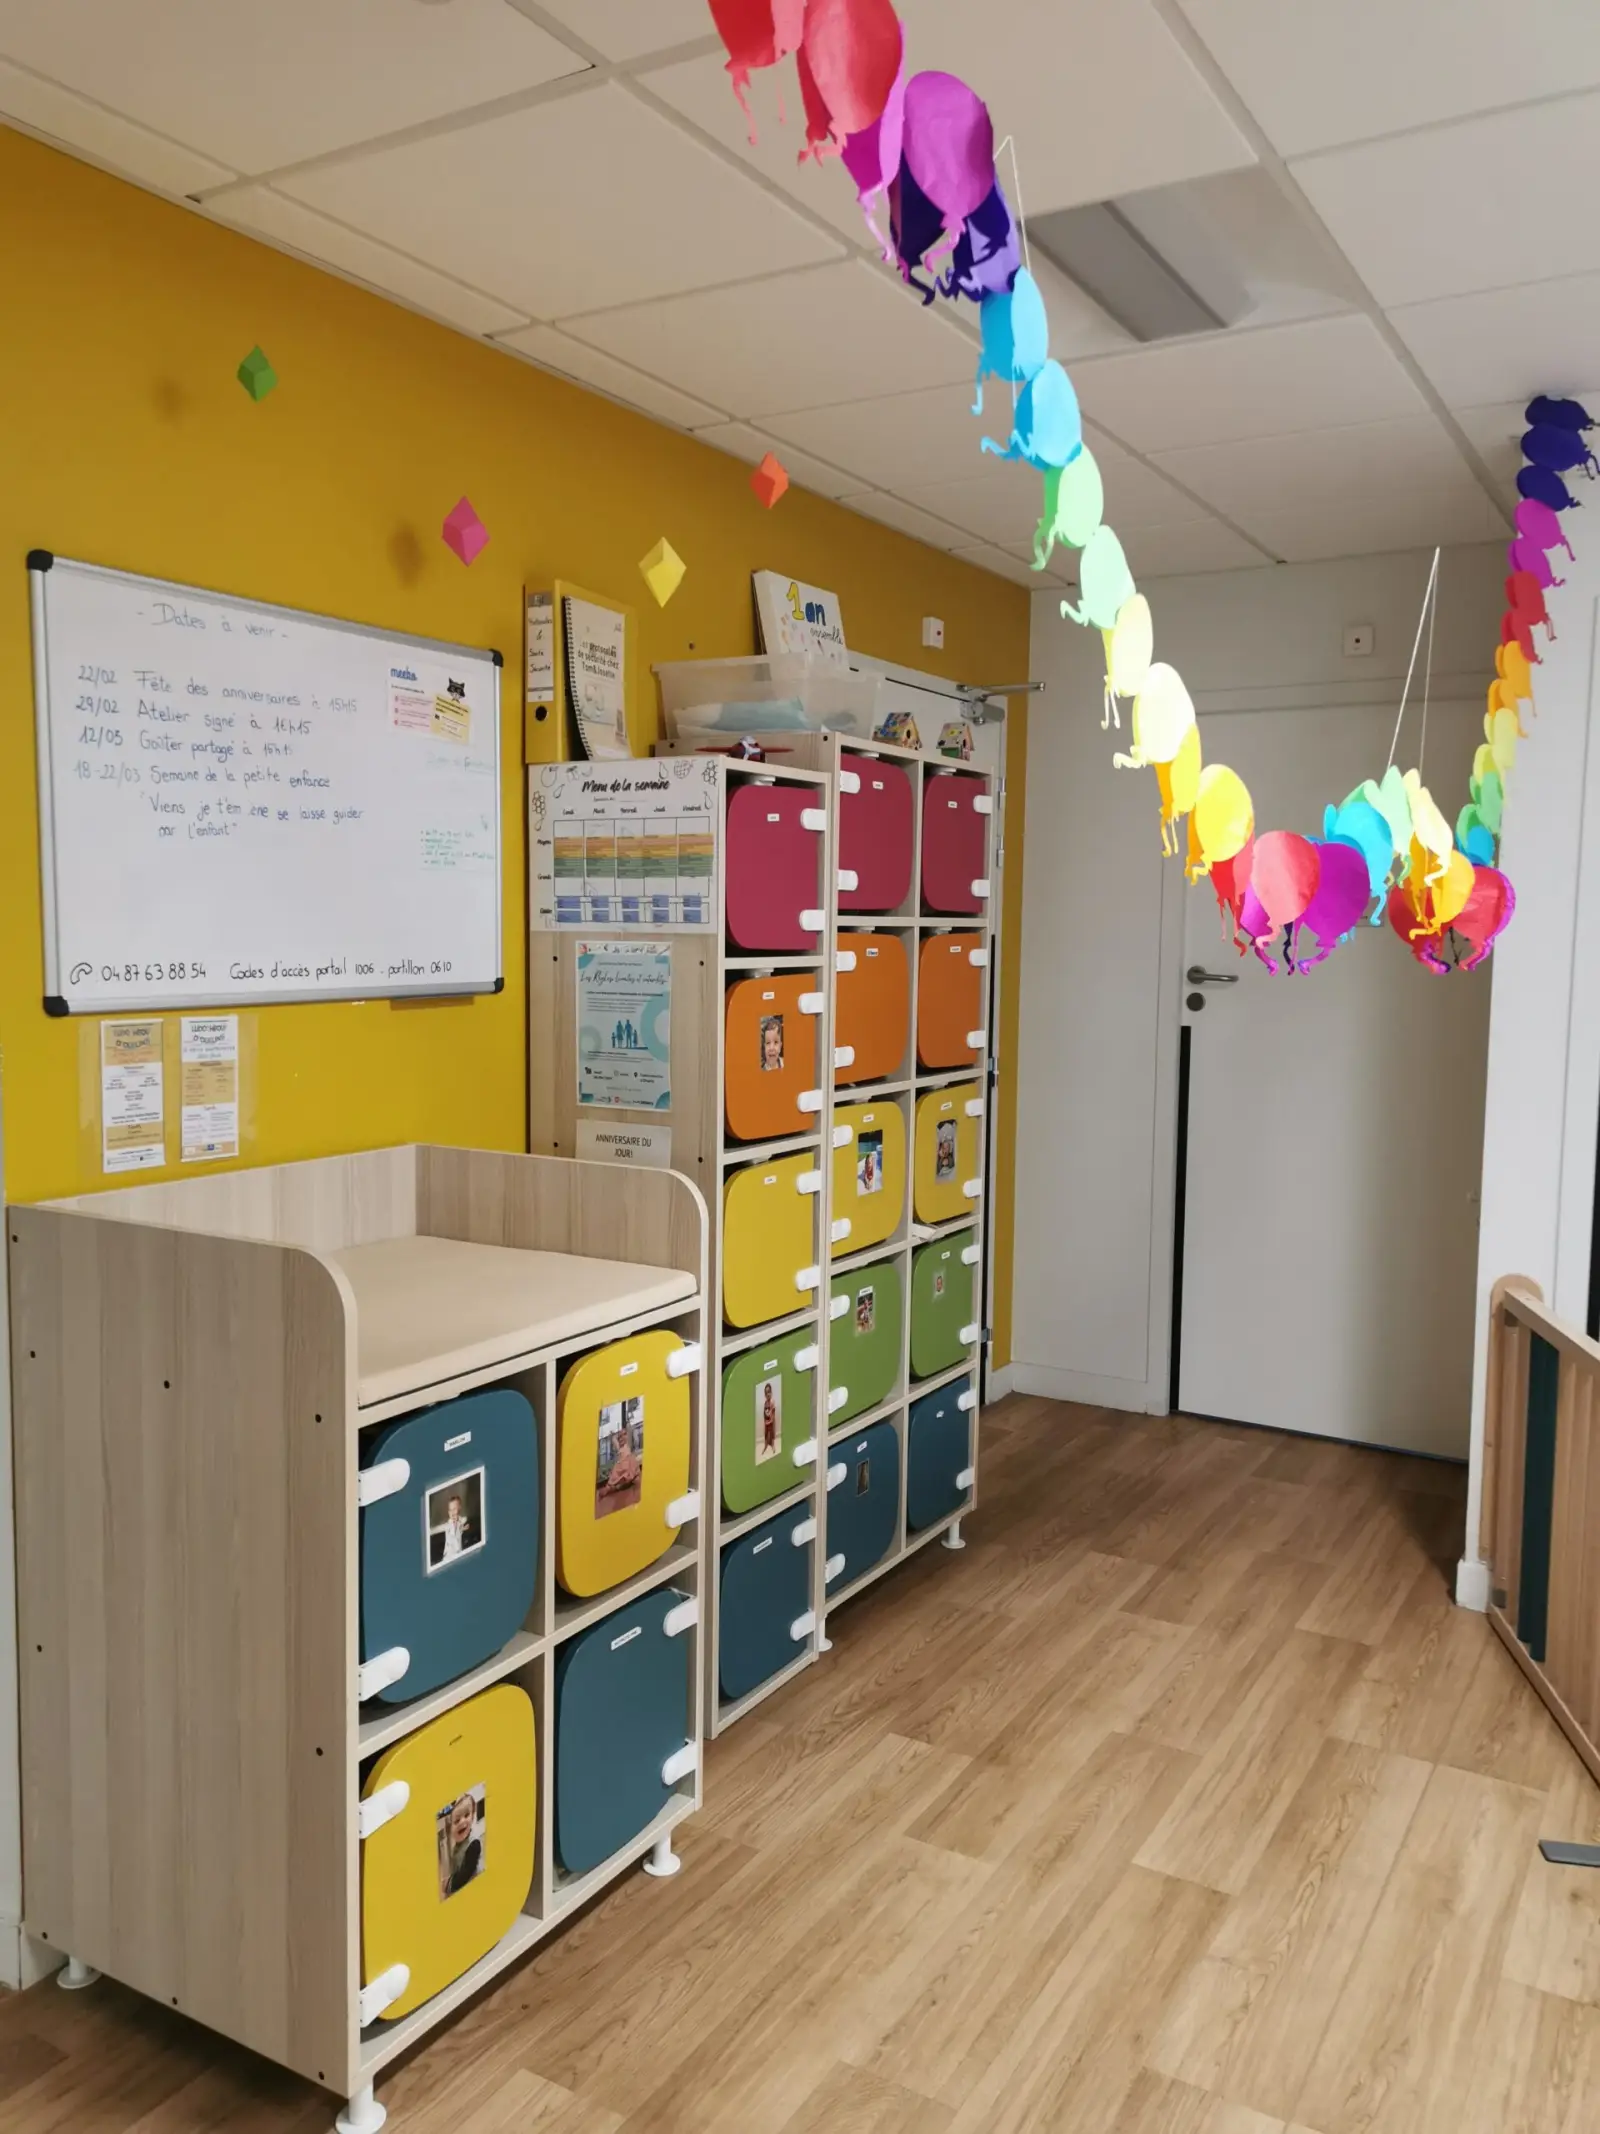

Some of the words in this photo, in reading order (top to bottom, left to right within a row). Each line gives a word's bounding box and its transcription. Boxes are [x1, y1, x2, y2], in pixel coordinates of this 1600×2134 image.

[786, 582, 805, 620] 1
[805, 602, 826, 626] an
[151, 602, 206, 629] Dates
[222, 616, 232, 632] à
[77, 665, 117, 688] 22/02
[133, 670, 172, 693] Fête
[187, 677, 208, 697] des
[76, 695, 120, 717] 29/02
[137, 699, 190, 723] Atelier
[250, 713, 262, 730] à
[191, 740, 234, 763] partagé
[150, 765, 199, 784] Semaine
[205, 766, 217, 782] de
[290, 769, 331, 788] enfance
[581, 780, 608, 794] Menu
[634, 778, 671, 792] semaine
[101, 965, 120, 982] 04
[124, 964, 140, 981] 87
[144, 963, 164, 981] 63
[169, 962, 186, 980] 88
[191, 962, 206, 978] 54
[230, 962, 265, 980] Codes
[270, 960, 310, 979] d'accès
[316, 957, 347, 981] portail
[355, 962, 375, 975] 1006
[430, 961, 452, 974] 0610
[595, 1133, 640, 1146] ANNIVERSAIRE
[641, 1137, 652, 1147] DU
